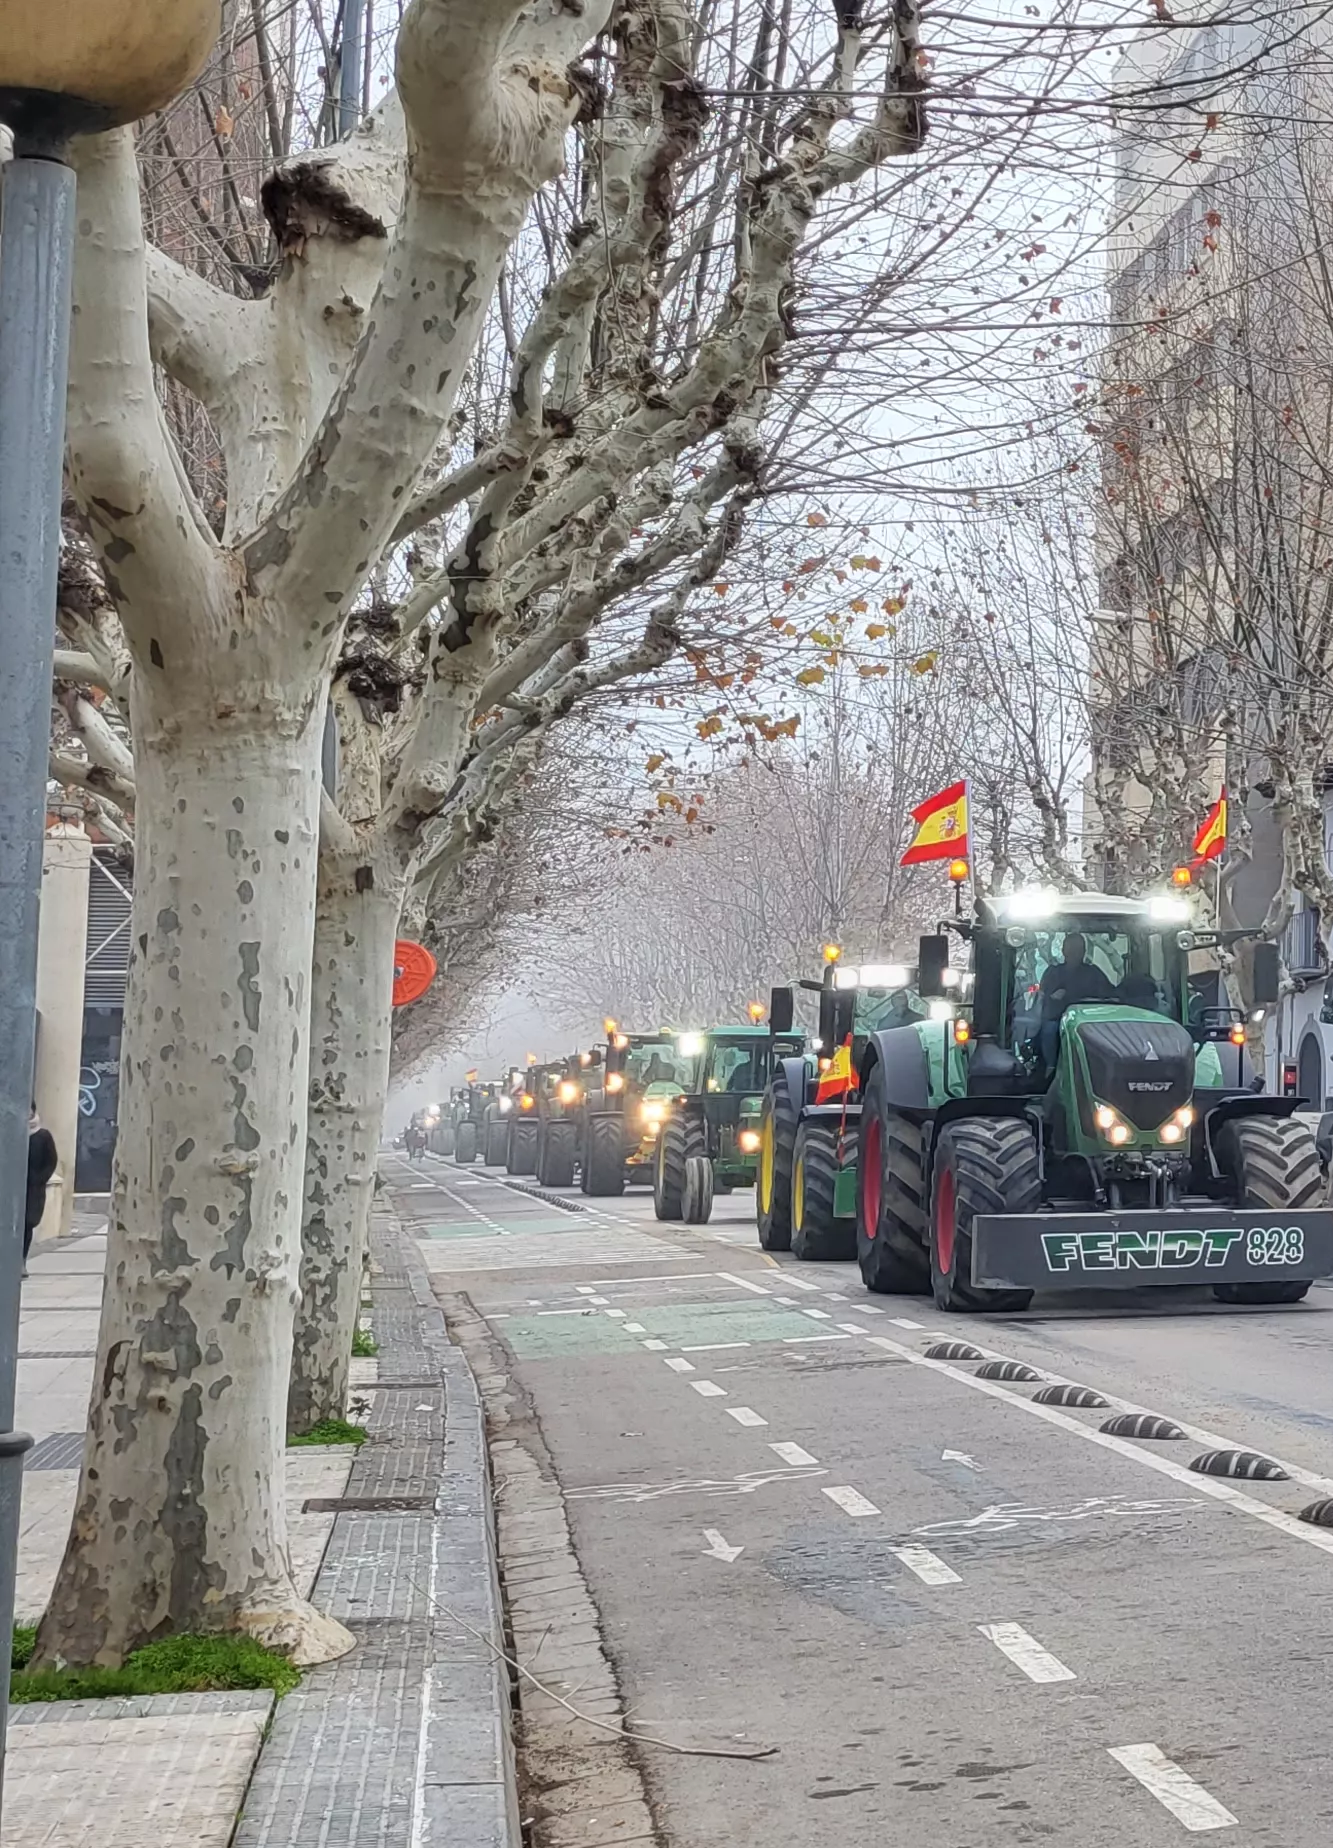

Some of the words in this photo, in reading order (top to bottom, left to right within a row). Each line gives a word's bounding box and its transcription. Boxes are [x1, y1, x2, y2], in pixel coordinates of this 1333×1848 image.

[1128, 1081, 1173, 1092] FENDT
[1041, 1229, 1244, 1271] FENDT
[1246, 1227, 1305, 1266] 828
